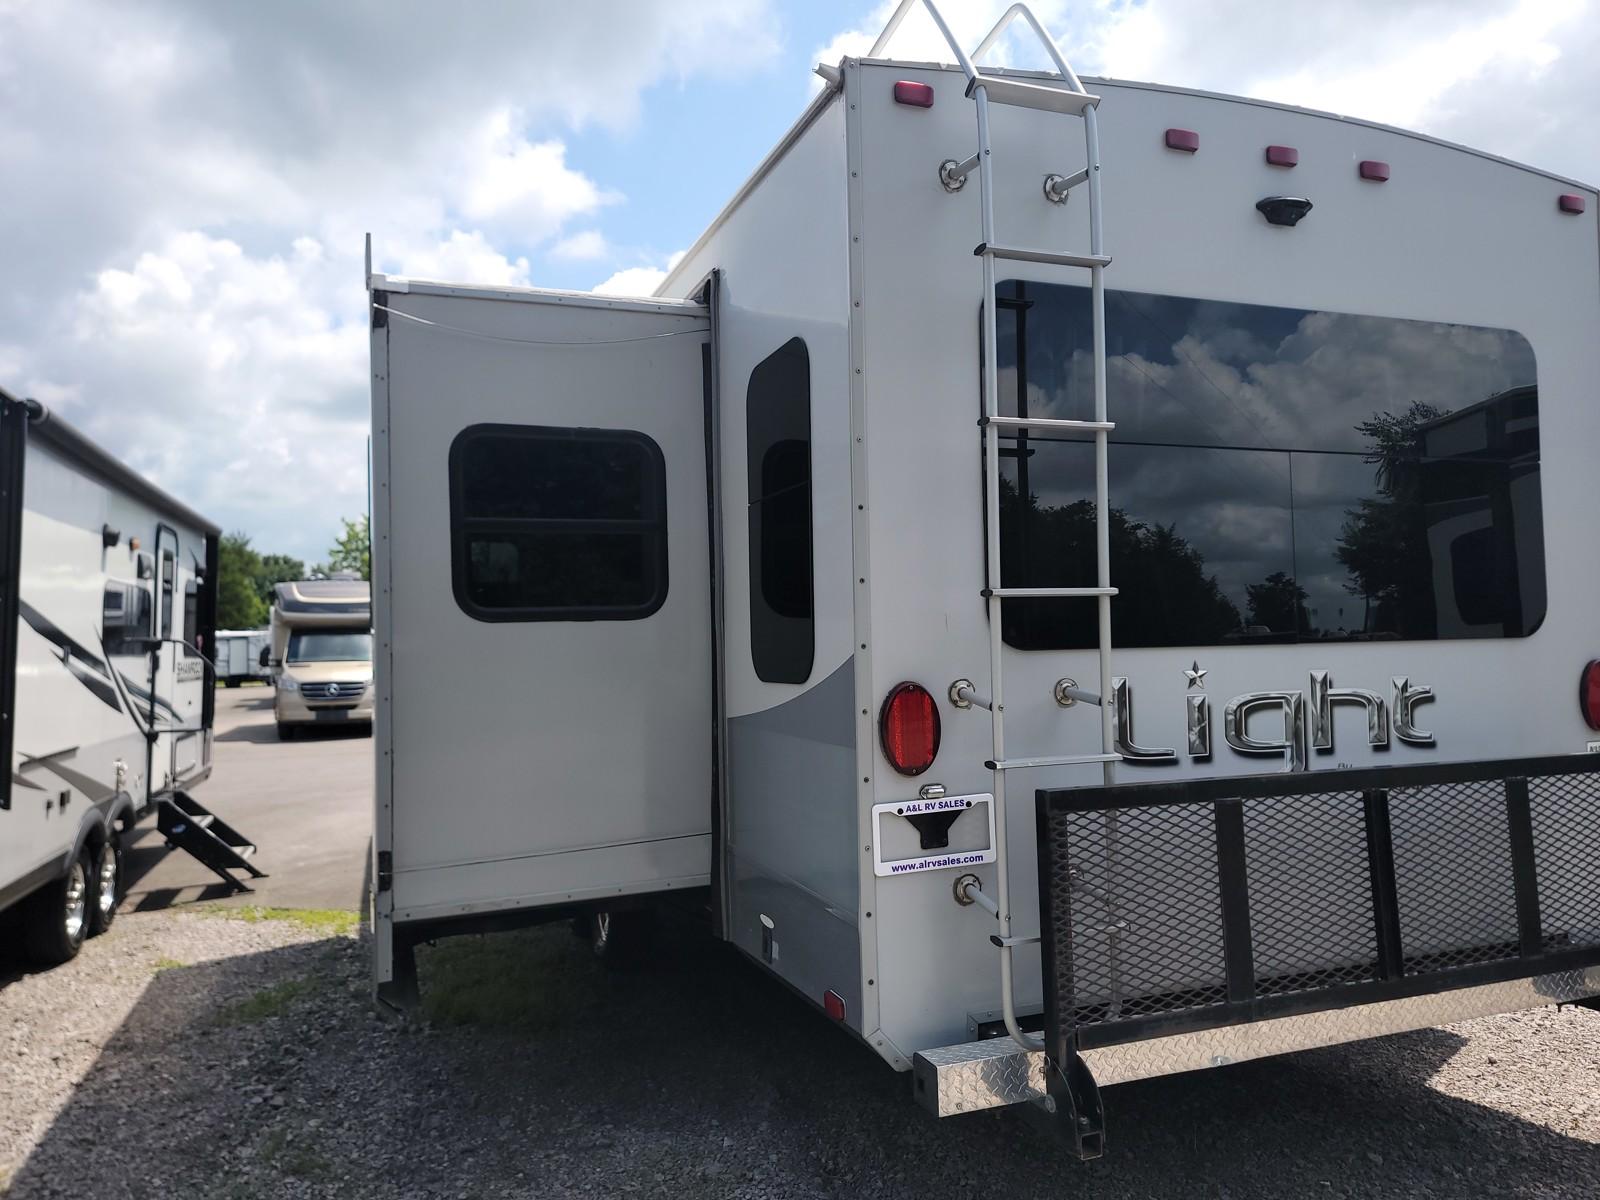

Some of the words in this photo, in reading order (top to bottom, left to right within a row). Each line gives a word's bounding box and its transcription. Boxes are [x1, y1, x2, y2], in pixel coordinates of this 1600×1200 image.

[1110, 661, 1433, 773] Light
[906, 804, 923, 812] A&L
[925, 802, 936, 810] RV
[938, 800, 965, 809] SALES
[891, 855, 984, 872] www.alrvsales.com
